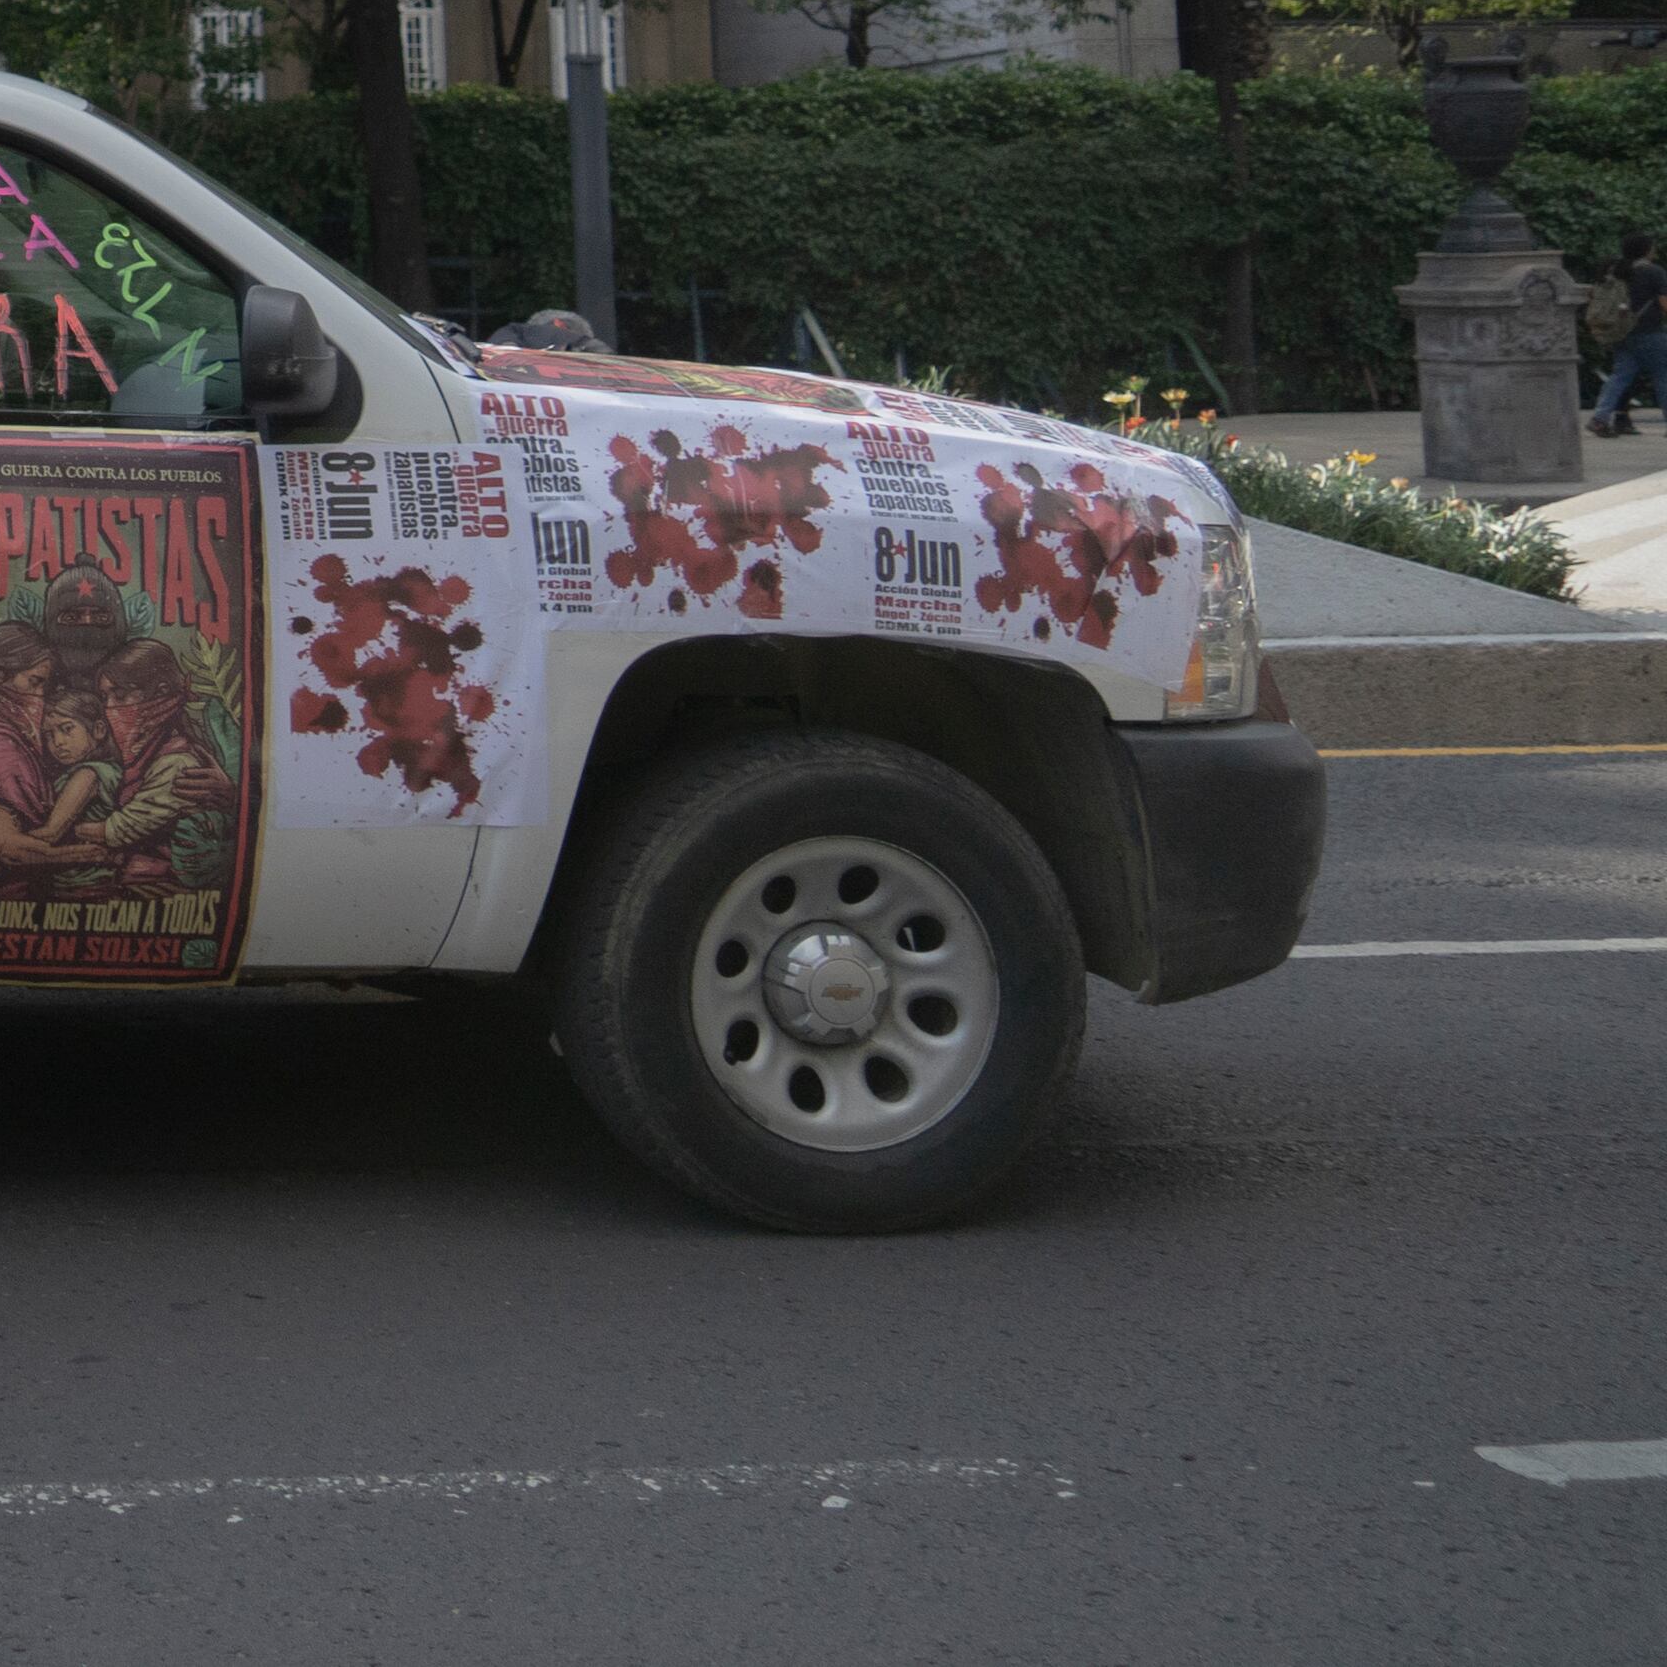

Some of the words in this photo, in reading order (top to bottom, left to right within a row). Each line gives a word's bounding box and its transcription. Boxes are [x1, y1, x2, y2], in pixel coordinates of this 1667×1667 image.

[93, 222, 225, 390] EZLN
[481, 392, 566, 418] ALTO
[495, 416, 568, 437] guerra
[845, 421, 930, 445] ALTO
[862, 441, 936, 462] guerra
[1, 465, 63, 478] GUERRA
[66, 466, 128, 480] CONTRA
[130, 468, 156, 481] LOS
[160, 468, 222, 483] PUEBLOS
[856, 458, 931, 479] contra
[297, 451, 314, 540] Marcha
[393, 450, 418, 539] zapatistas
[411, 451, 439, 540] pueblos
[433, 452, 459, 528] contra
[472, 451, 509, 539] ALTO
[860, 476, 949, 497] pueblos
[452, 464, 482, 538] guerra
[865, 493, 954, 514] zapatistas
[548, 566, 591, 576] Global
[875, 595, 962, 613] Marcha
[921, 587, 962, 599] Global
[552, 603, 563, 613] 4
[567, 603, 592, 614] pm
[875, 620, 920, 631] CDMX
[923, 622, 933, 633] 4
[43, 902, 81, 931] NOS
[143, 900, 155, 933] A
[161, 890, 222, 934] TODXS
[81, 937, 181, 964] SOLXS!
